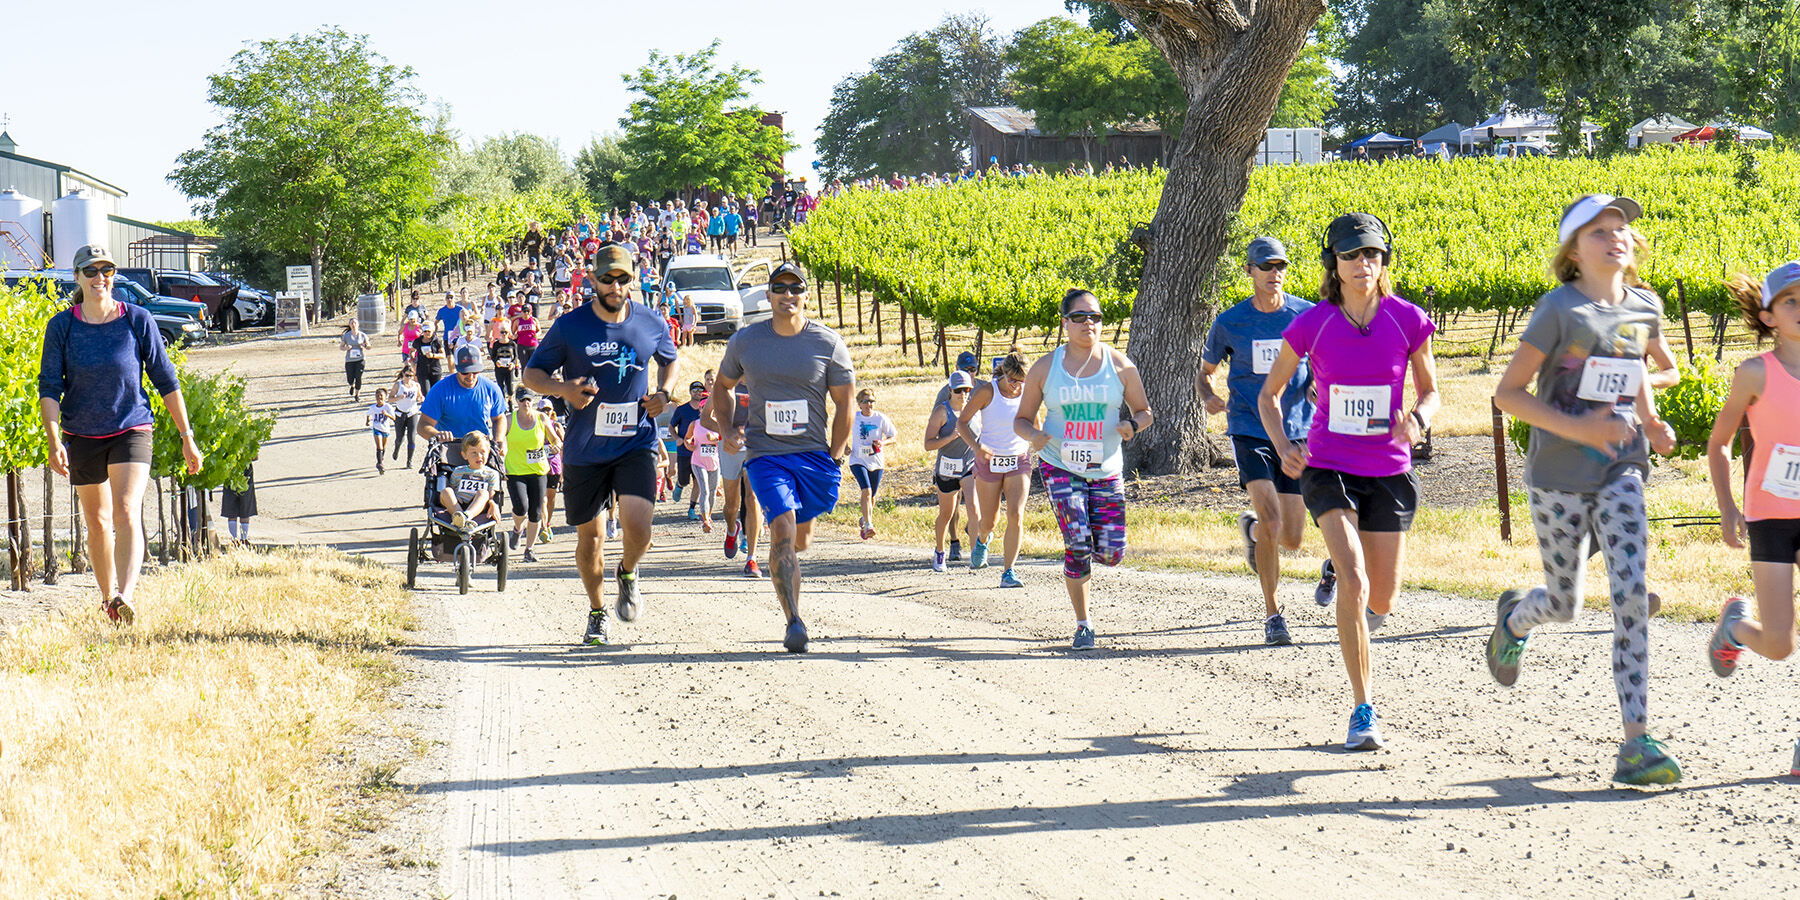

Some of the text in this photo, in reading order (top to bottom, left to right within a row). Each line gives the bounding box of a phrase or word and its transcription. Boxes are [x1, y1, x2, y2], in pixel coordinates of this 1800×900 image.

[601, 342, 618, 350] SLO
[1262, 348, 1280, 361] 120
[1596, 373, 1628, 393] 1158
[1060, 384, 1109, 403] DON'T
[1061, 403, 1107, 421] WALK
[1344, 399, 1374, 417] 1199
[606, 411, 628, 424] 1034
[774, 410, 797, 423] 1032
[1064, 421, 1104, 440] RUN!
[992, 457, 1016, 467] 1235
[1071, 450, 1092, 462] 1155
[1785, 461, 1800, 481] 11
[461, 480, 485, 491] 1241
